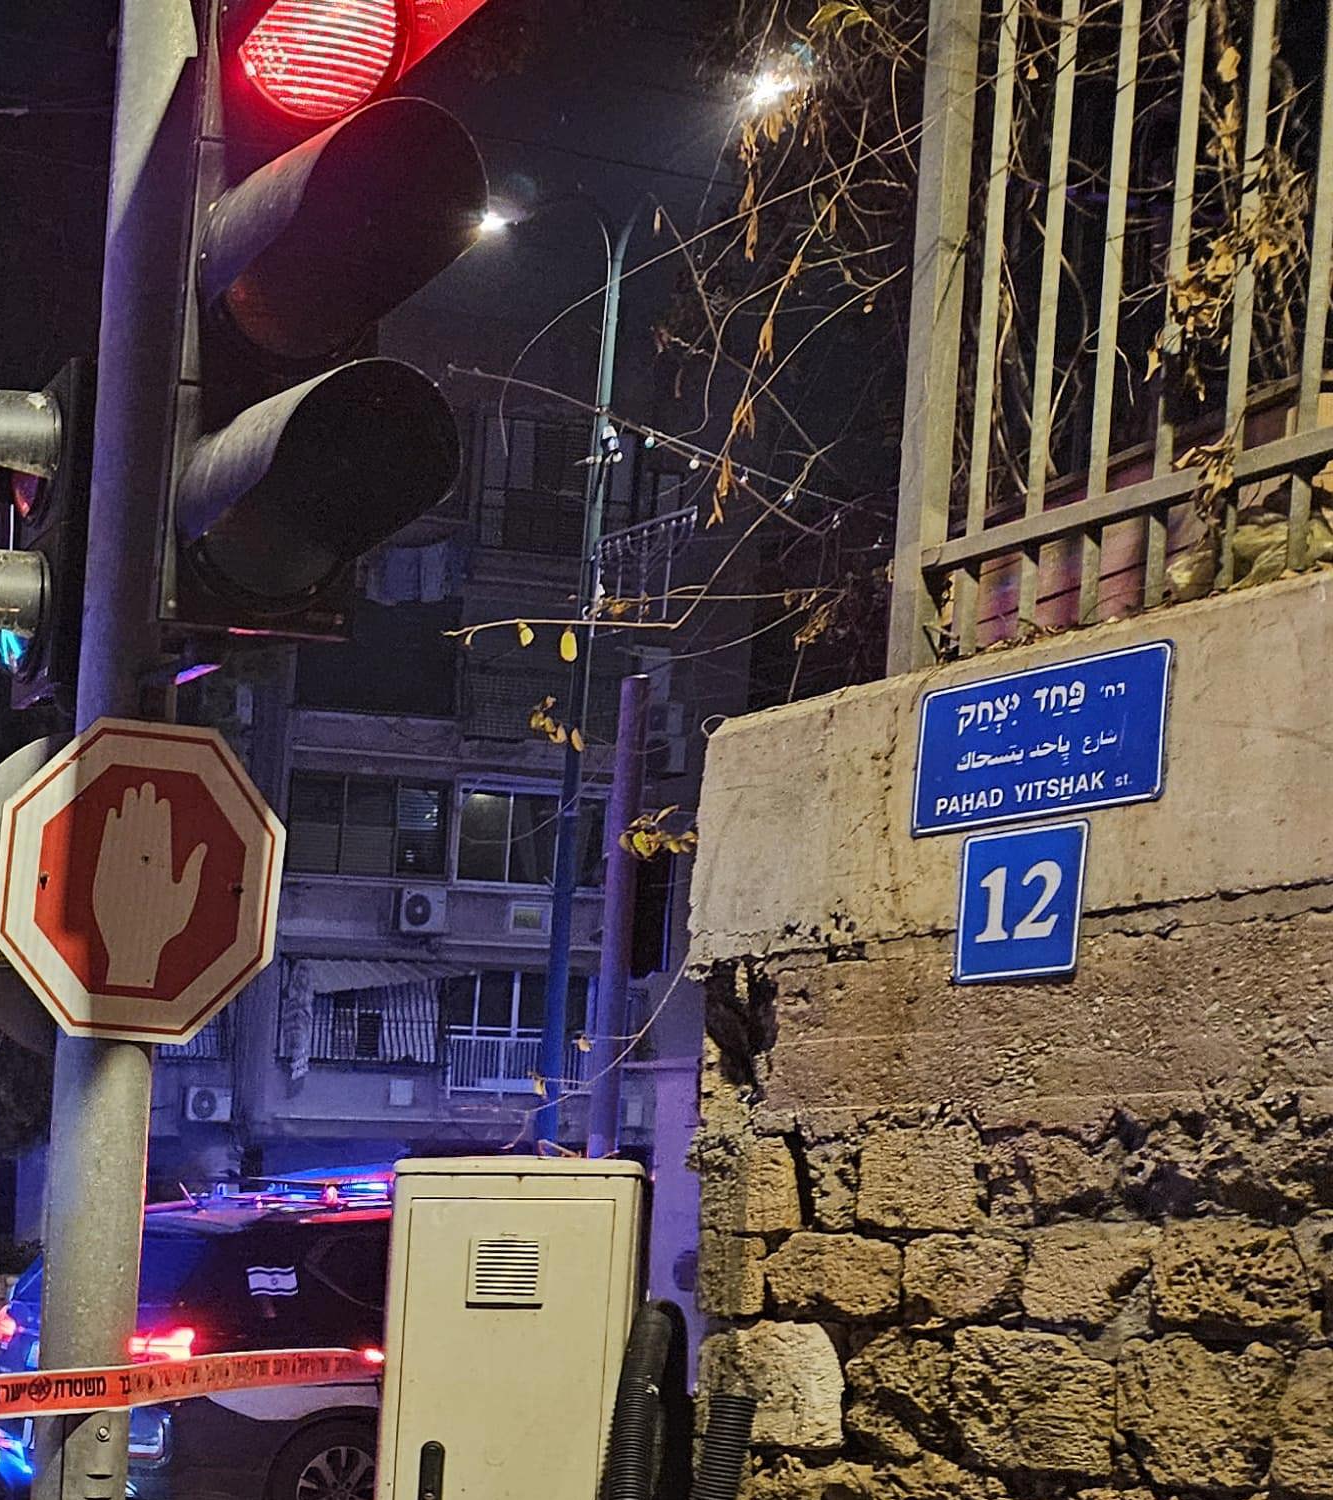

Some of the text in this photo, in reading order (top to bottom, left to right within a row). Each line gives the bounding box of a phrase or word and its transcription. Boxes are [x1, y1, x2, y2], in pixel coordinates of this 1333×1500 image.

[1083, 729, 1118, 754] شارع
[935, 787, 1004, 817] PAHAD
[1014, 770, 1105, 801] YITSHAK
[975, 860, 1063, 944] 12
[53, 1376, 107, 1399] משטרת
